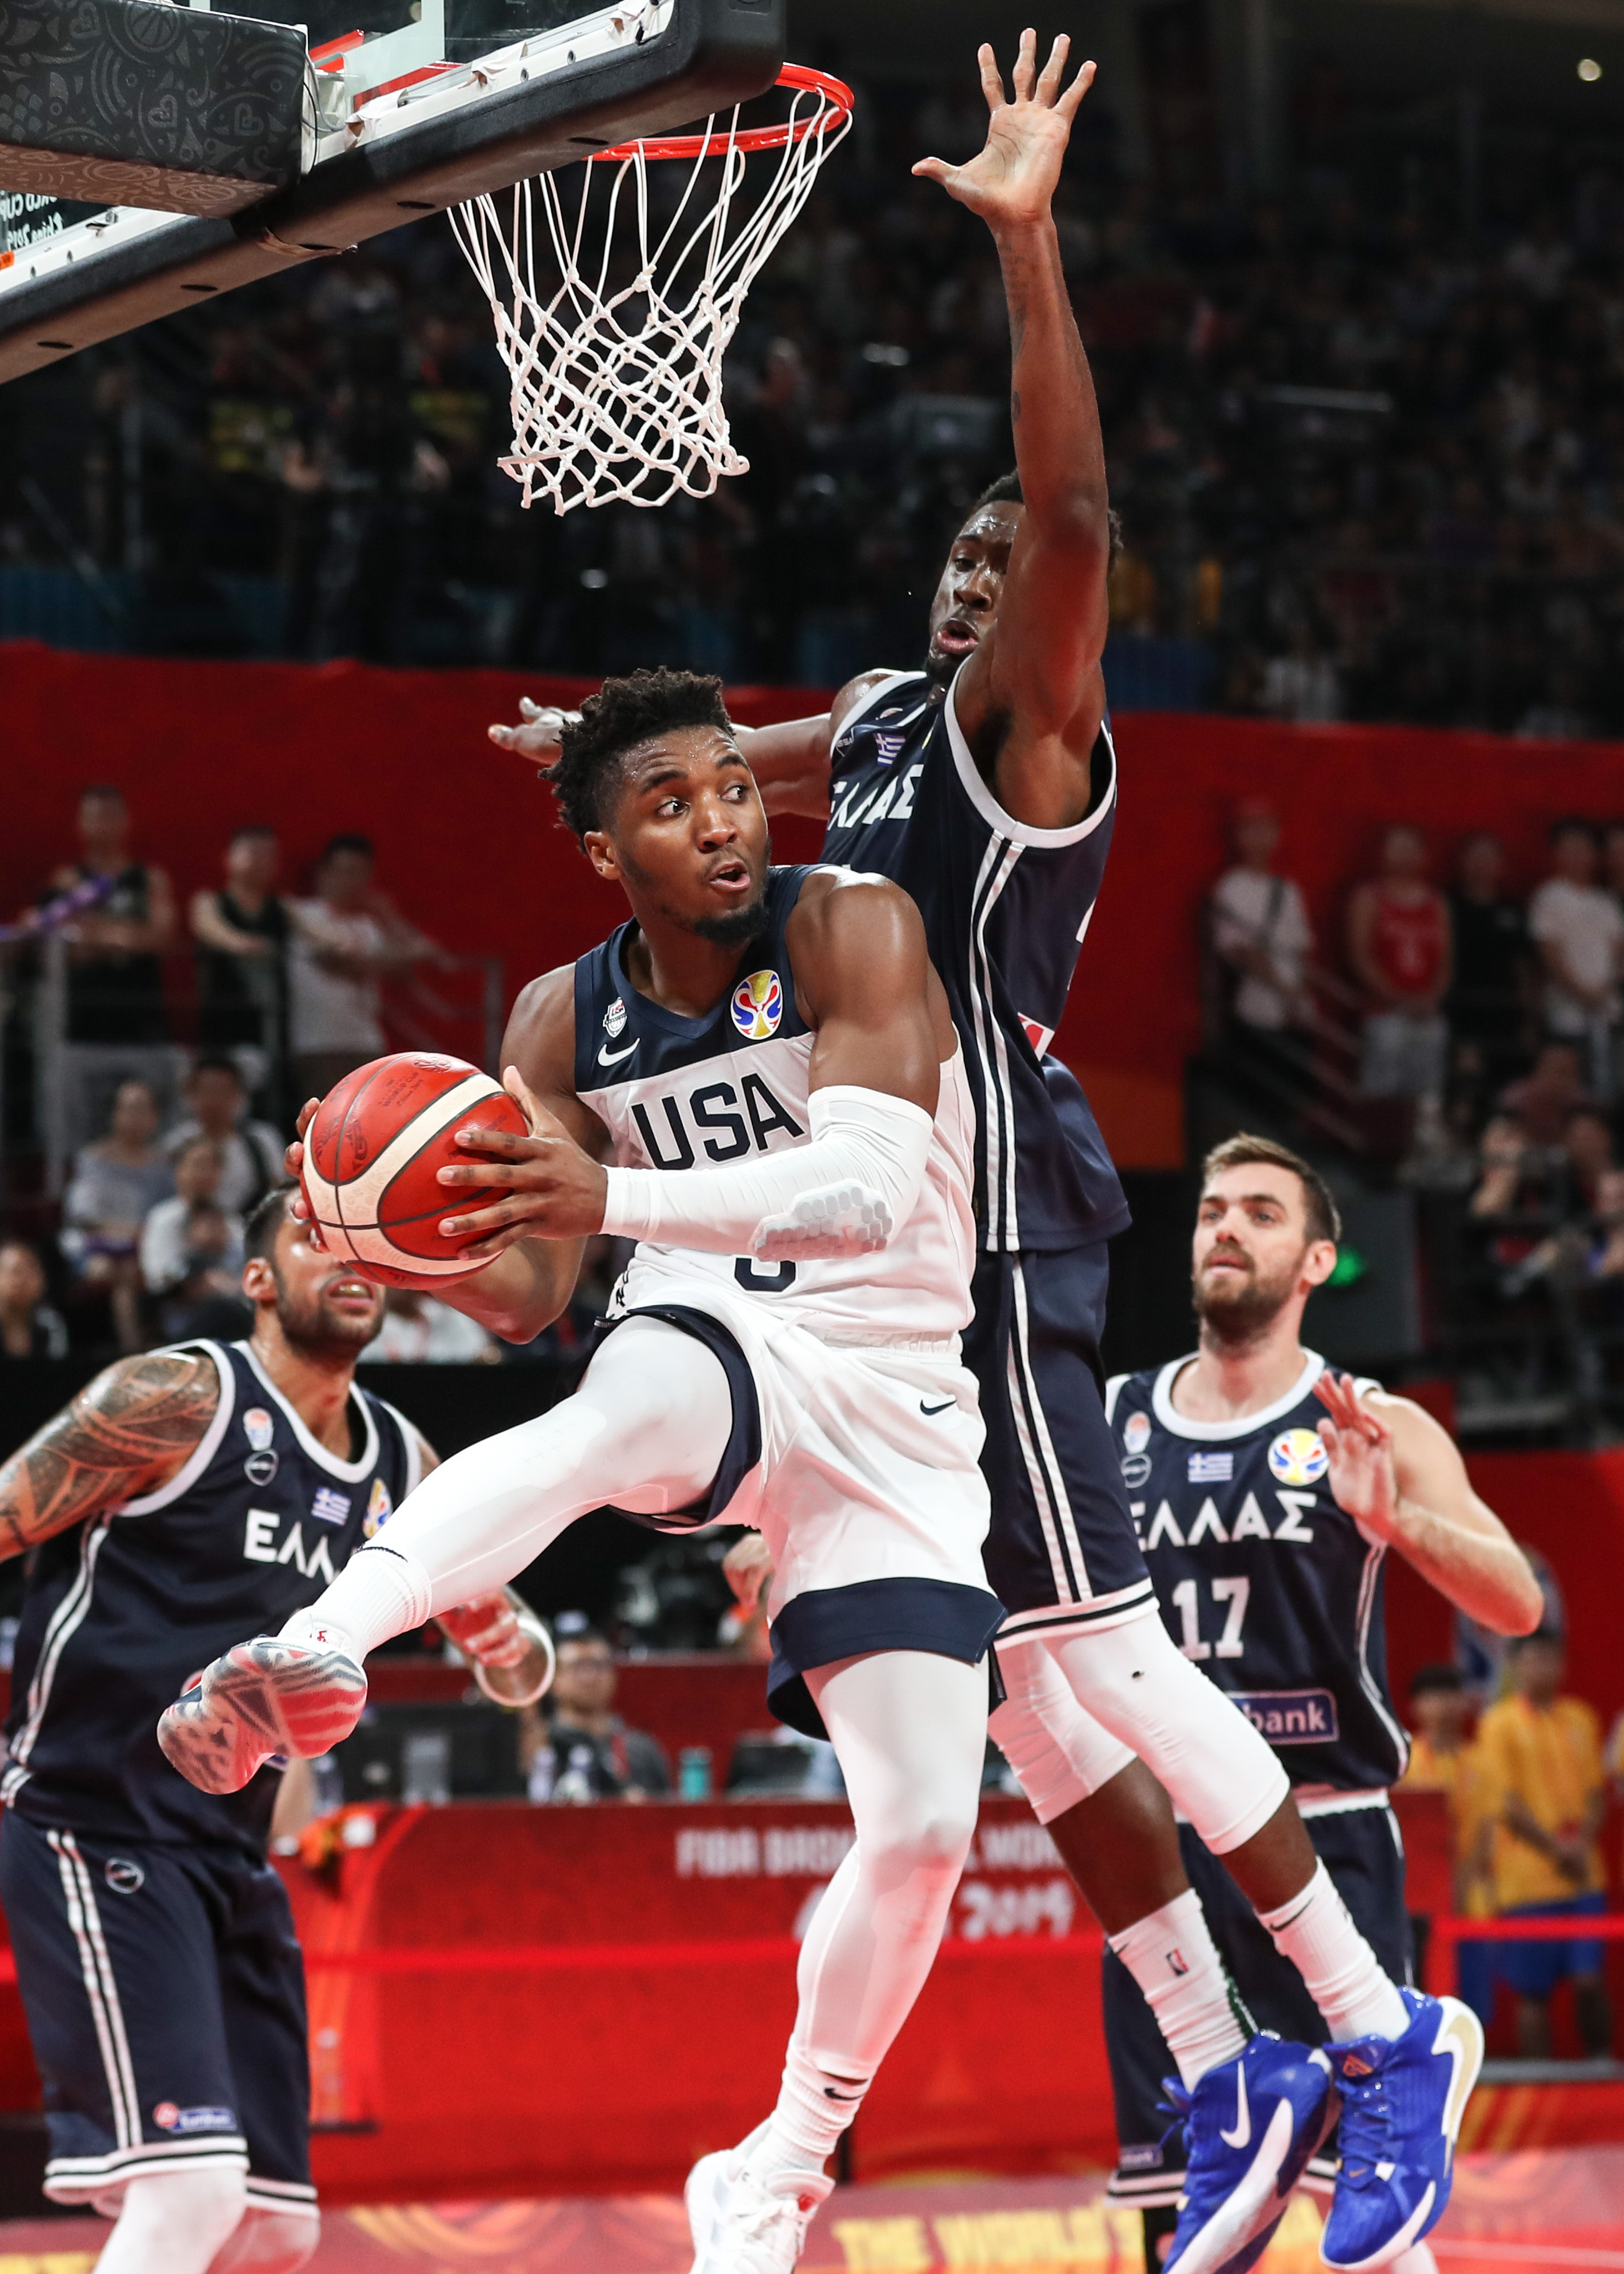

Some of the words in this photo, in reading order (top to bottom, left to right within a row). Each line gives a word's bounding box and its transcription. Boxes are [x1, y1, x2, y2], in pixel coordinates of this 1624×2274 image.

[631, 1073, 805, 1170] USA
[1172, 1575, 1250, 1661] 17
[1242, 1701, 1327, 1735] bank
[678, 1829, 759, 1878] FIBA
